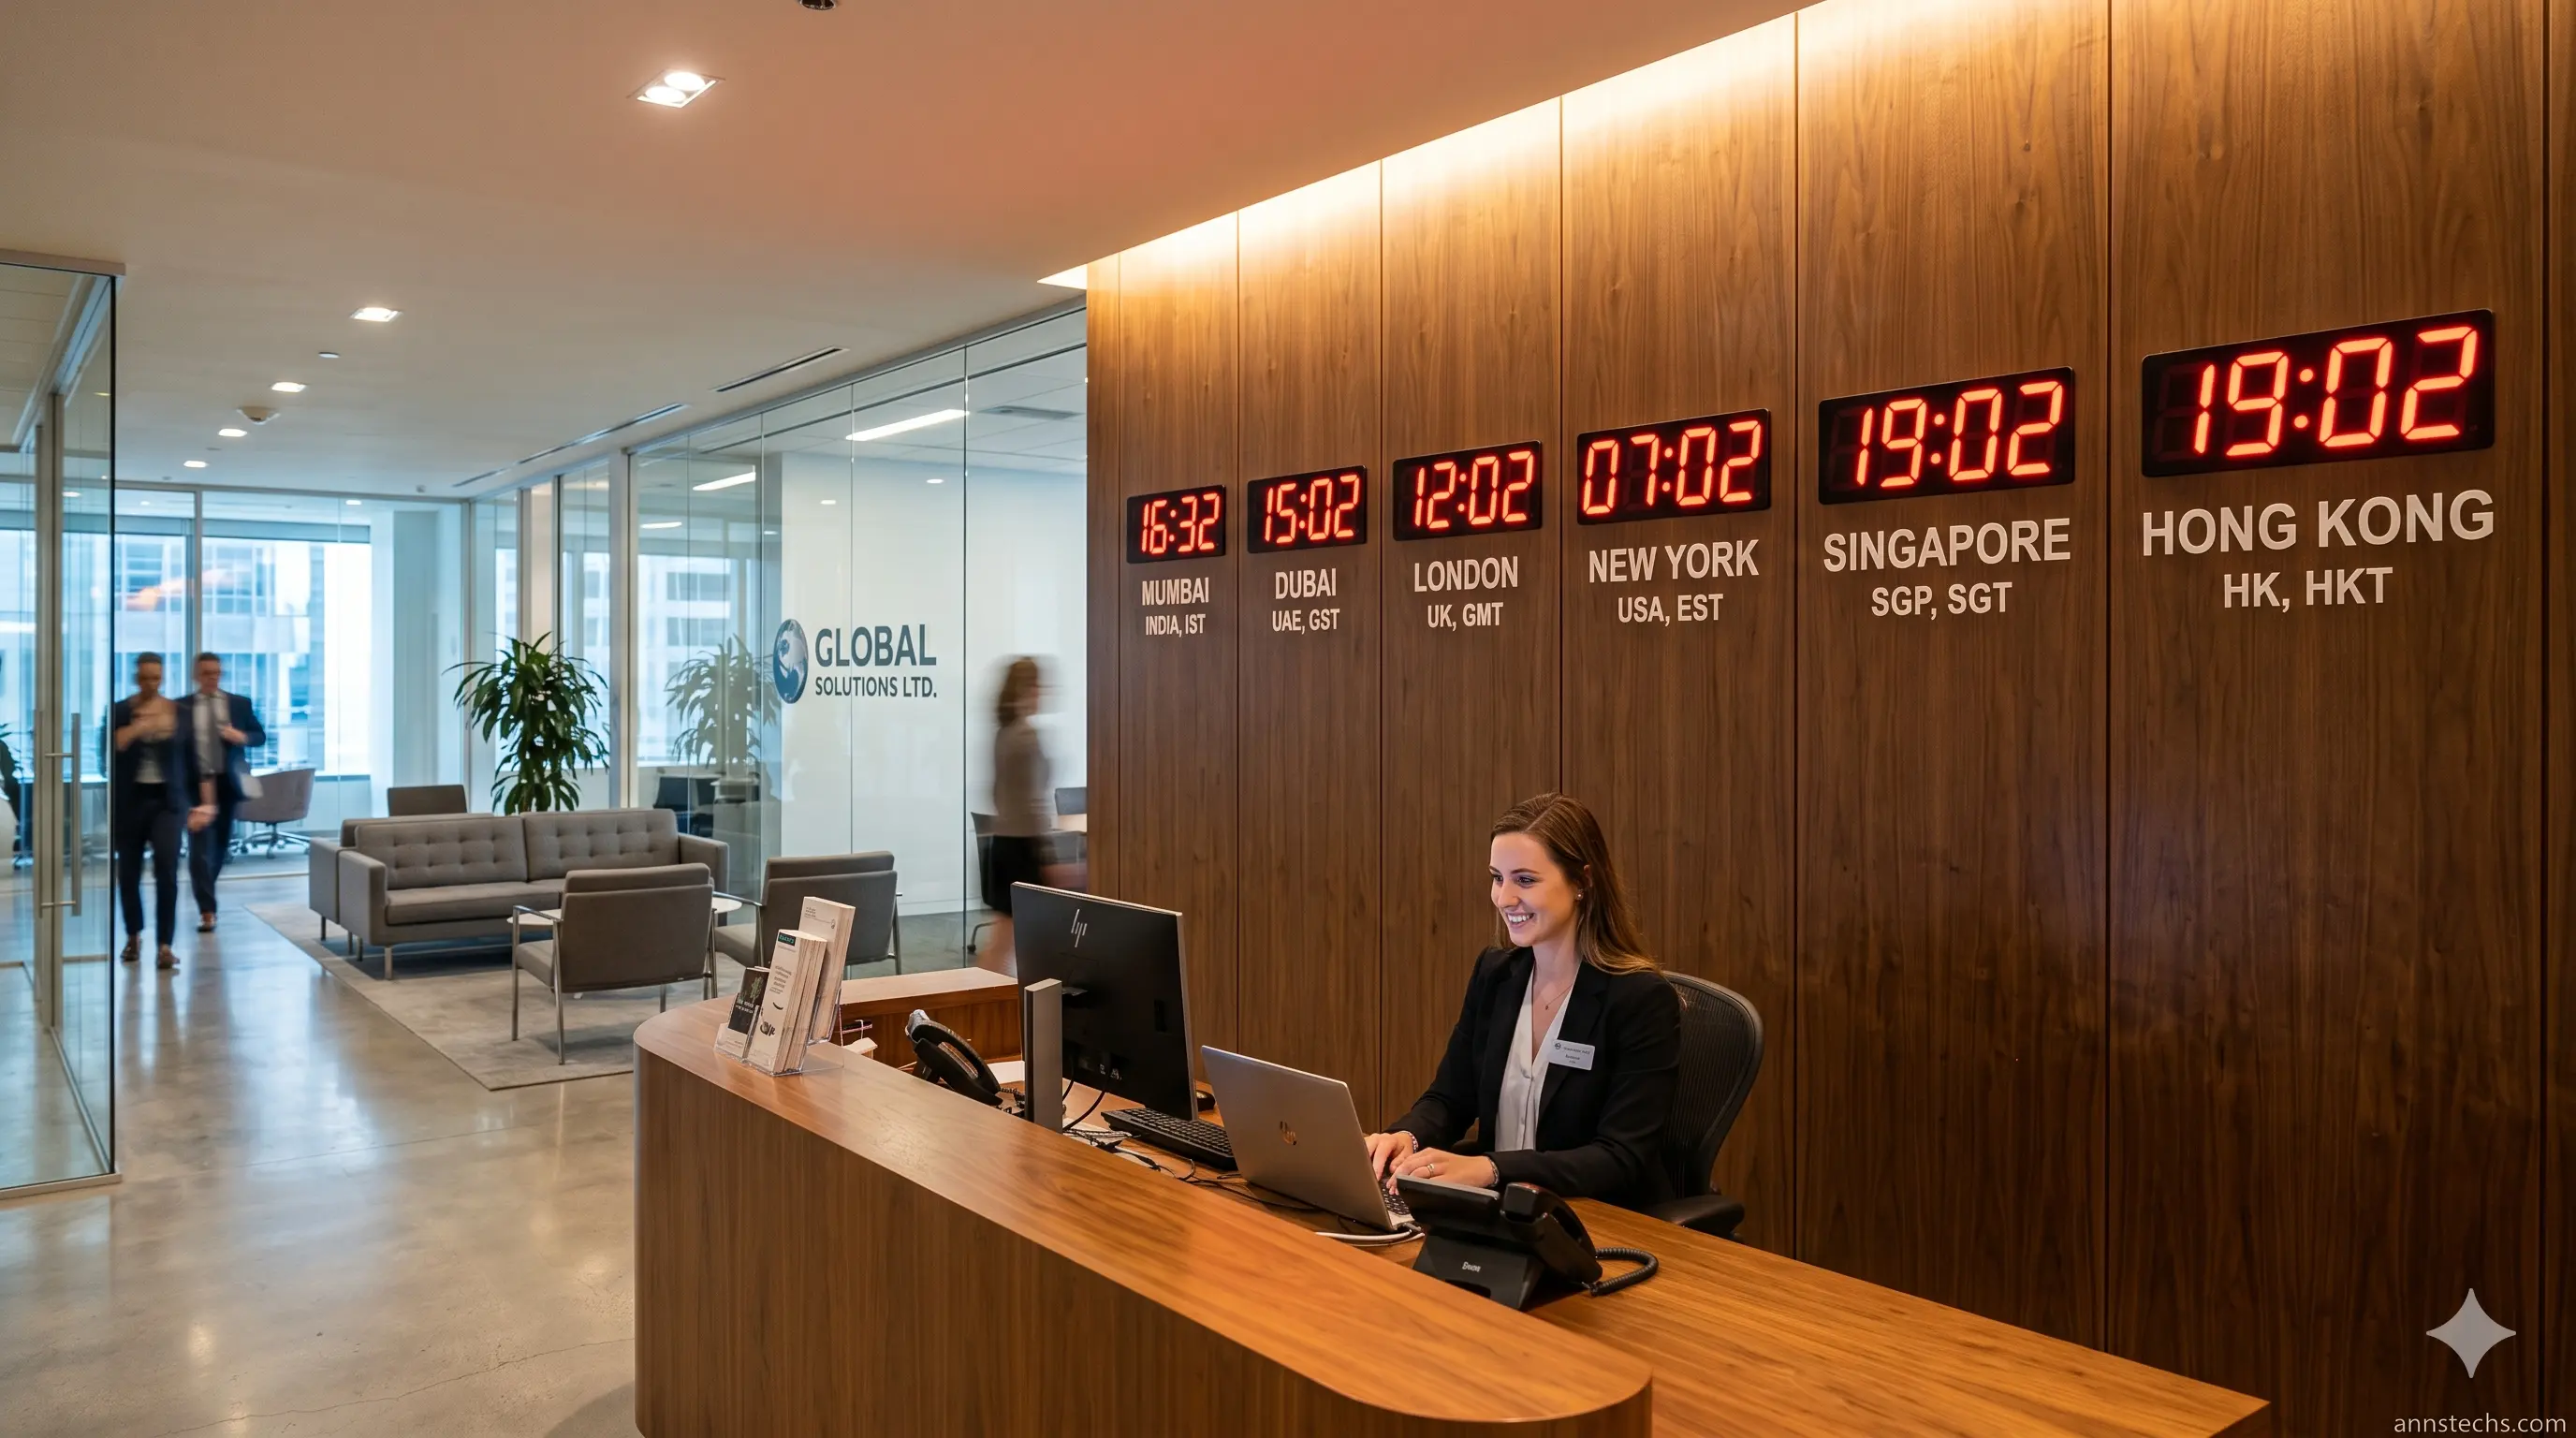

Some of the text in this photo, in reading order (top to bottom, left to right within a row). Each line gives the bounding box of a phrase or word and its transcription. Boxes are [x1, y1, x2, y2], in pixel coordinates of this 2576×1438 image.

[2193, 326, 2478, 457] 19:02
[1856, 380, 2063, 488] 19:02
[1414, 450, 1534, 529] 12:02
[1582, 419, 1762, 516] 07:02
[1141, 492, 1220, 554] 16:32
[1265, 474, 1360, 544] 15:02
[2143, 489, 2494, 556] HONG KONG
[1588, 539, 1760, 583] NEW YORK
[1823, 518, 2071, 572] SINGAPORE
[1142, 577, 1209, 606] MUMBAI
[1275, 567, 1337, 600] DUBAI
[1414, 555, 1518, 593] LONDON
[2224, 566, 2393, 613] HK, HKT
[1272, 608, 1340, 635] UAE, GST
[1427, 601, 1504, 632] UK, GMT
[1617, 593, 1724, 627] USA, EST
[1871, 581, 2012, 621] SGP, SGT
[814, 624, 937, 668] GLOBAL
[1145, 613, 1207, 638] INDIA, IST
[815, 676, 937, 698] SOLUTIONS LTD.
